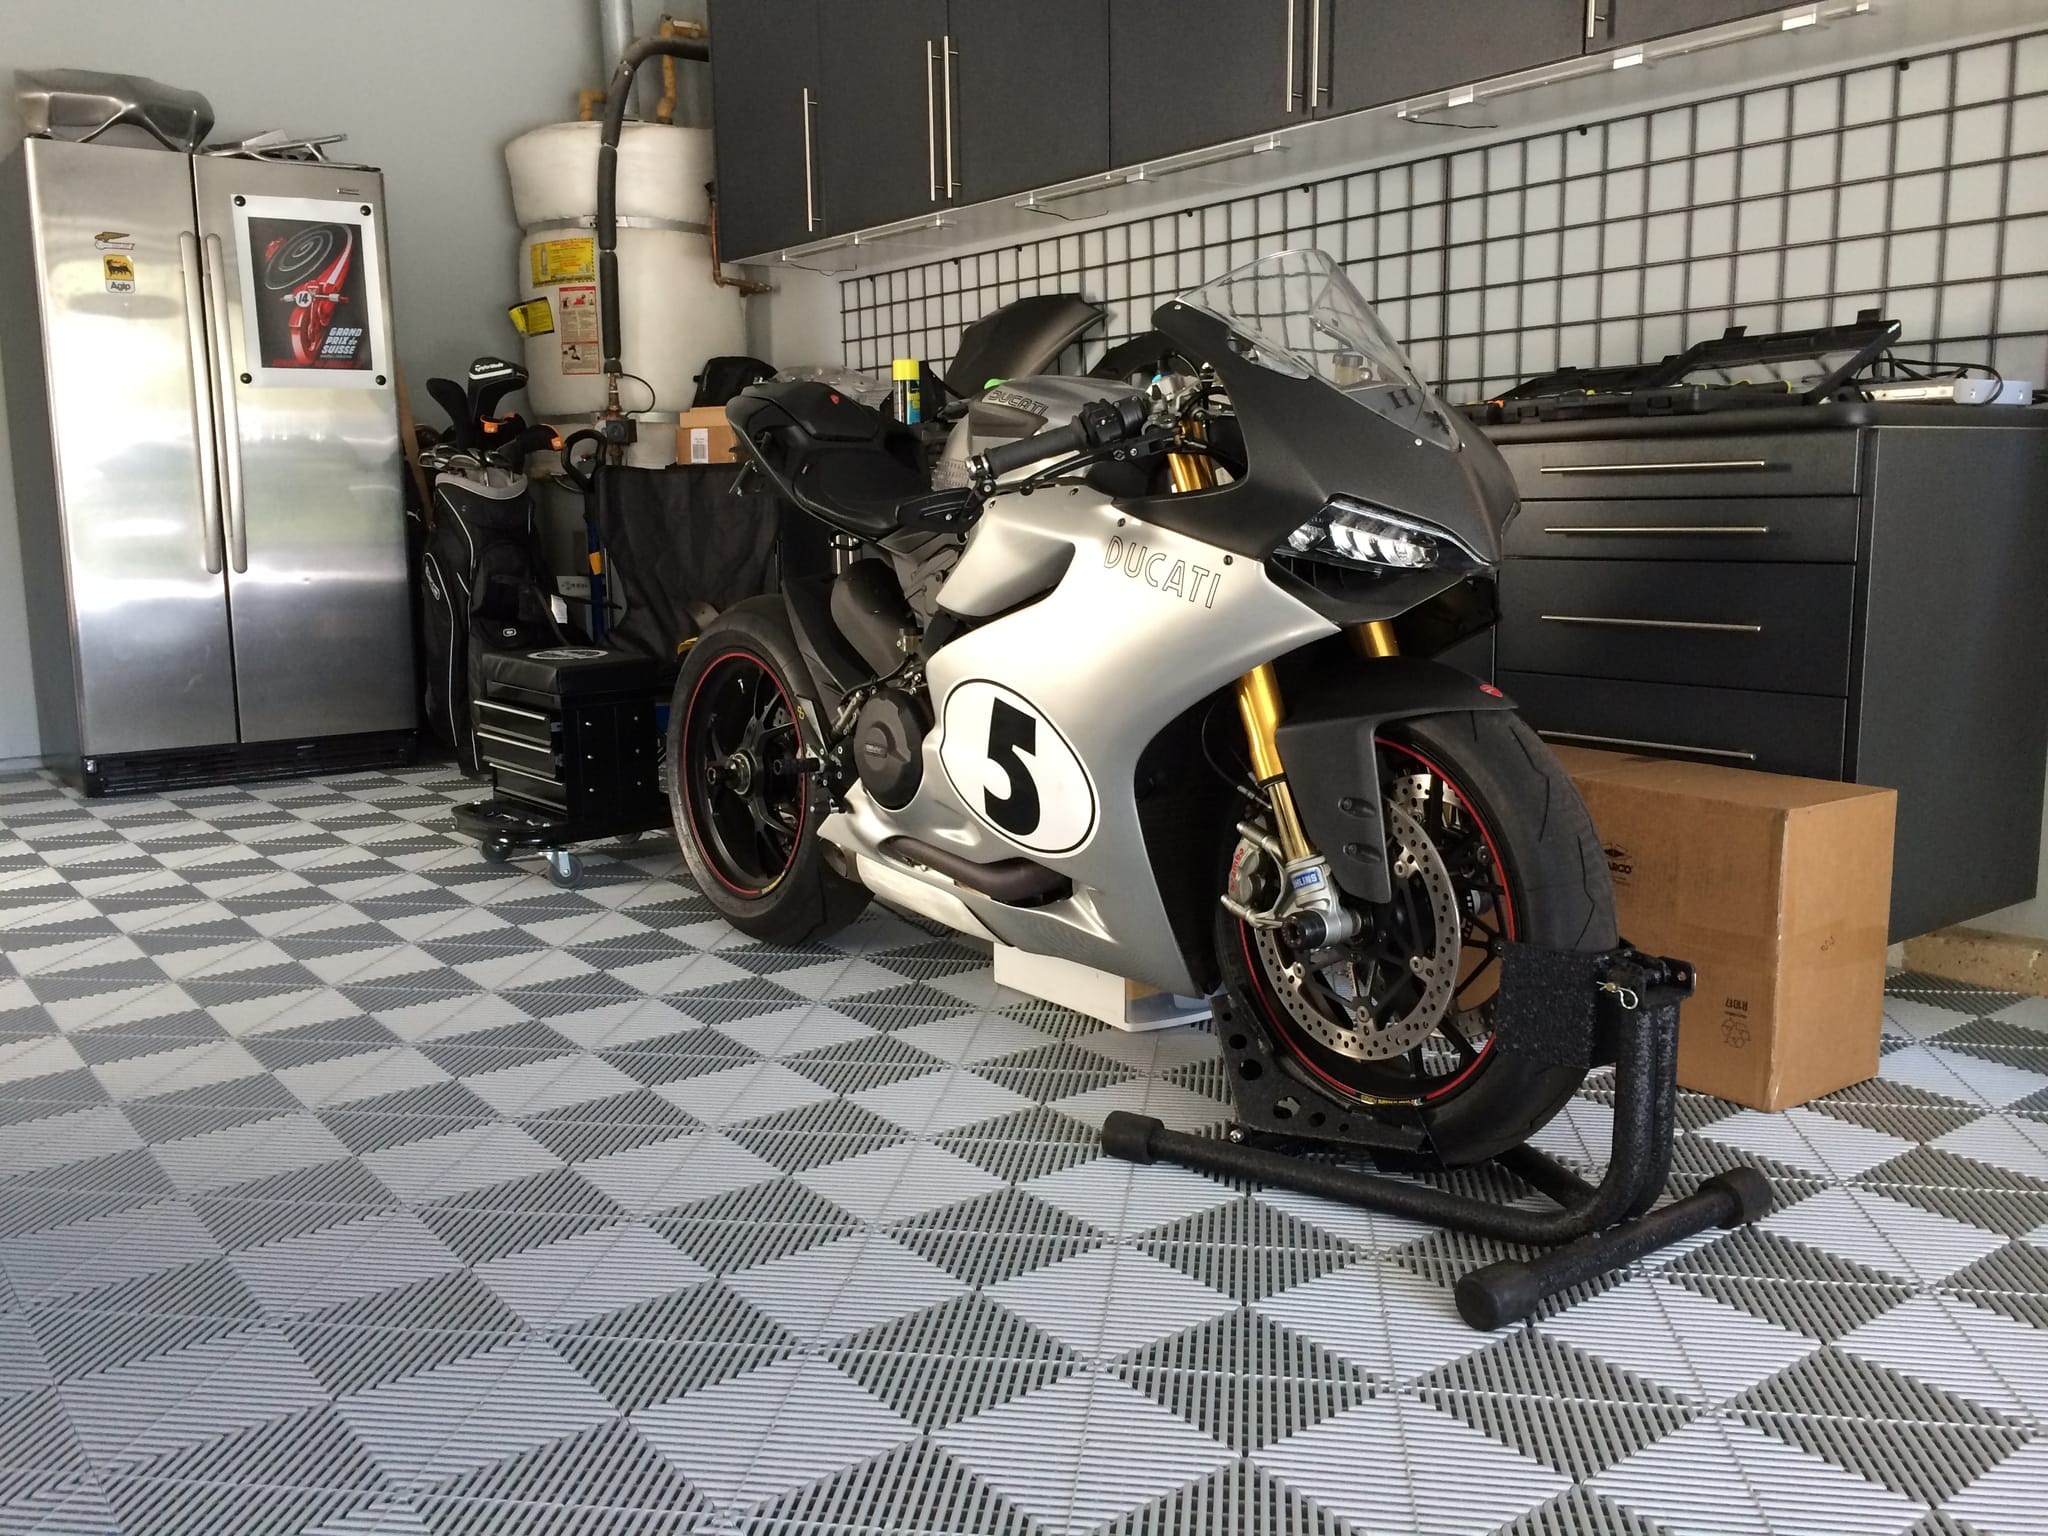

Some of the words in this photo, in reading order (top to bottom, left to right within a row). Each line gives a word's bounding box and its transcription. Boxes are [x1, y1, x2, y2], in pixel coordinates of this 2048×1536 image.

[111, 281, 131, 291] Agip
[298, 292, 309, 304] 14
[329, 327, 362, 336] GRAND
[325, 336, 347, 344] PRIX
[321, 345, 356, 354] SUISSE
[988, 389, 1049, 416] DUCATI
[1103, 535, 1222, 609] DUCATI
[983, 696, 1041, 836] 5
